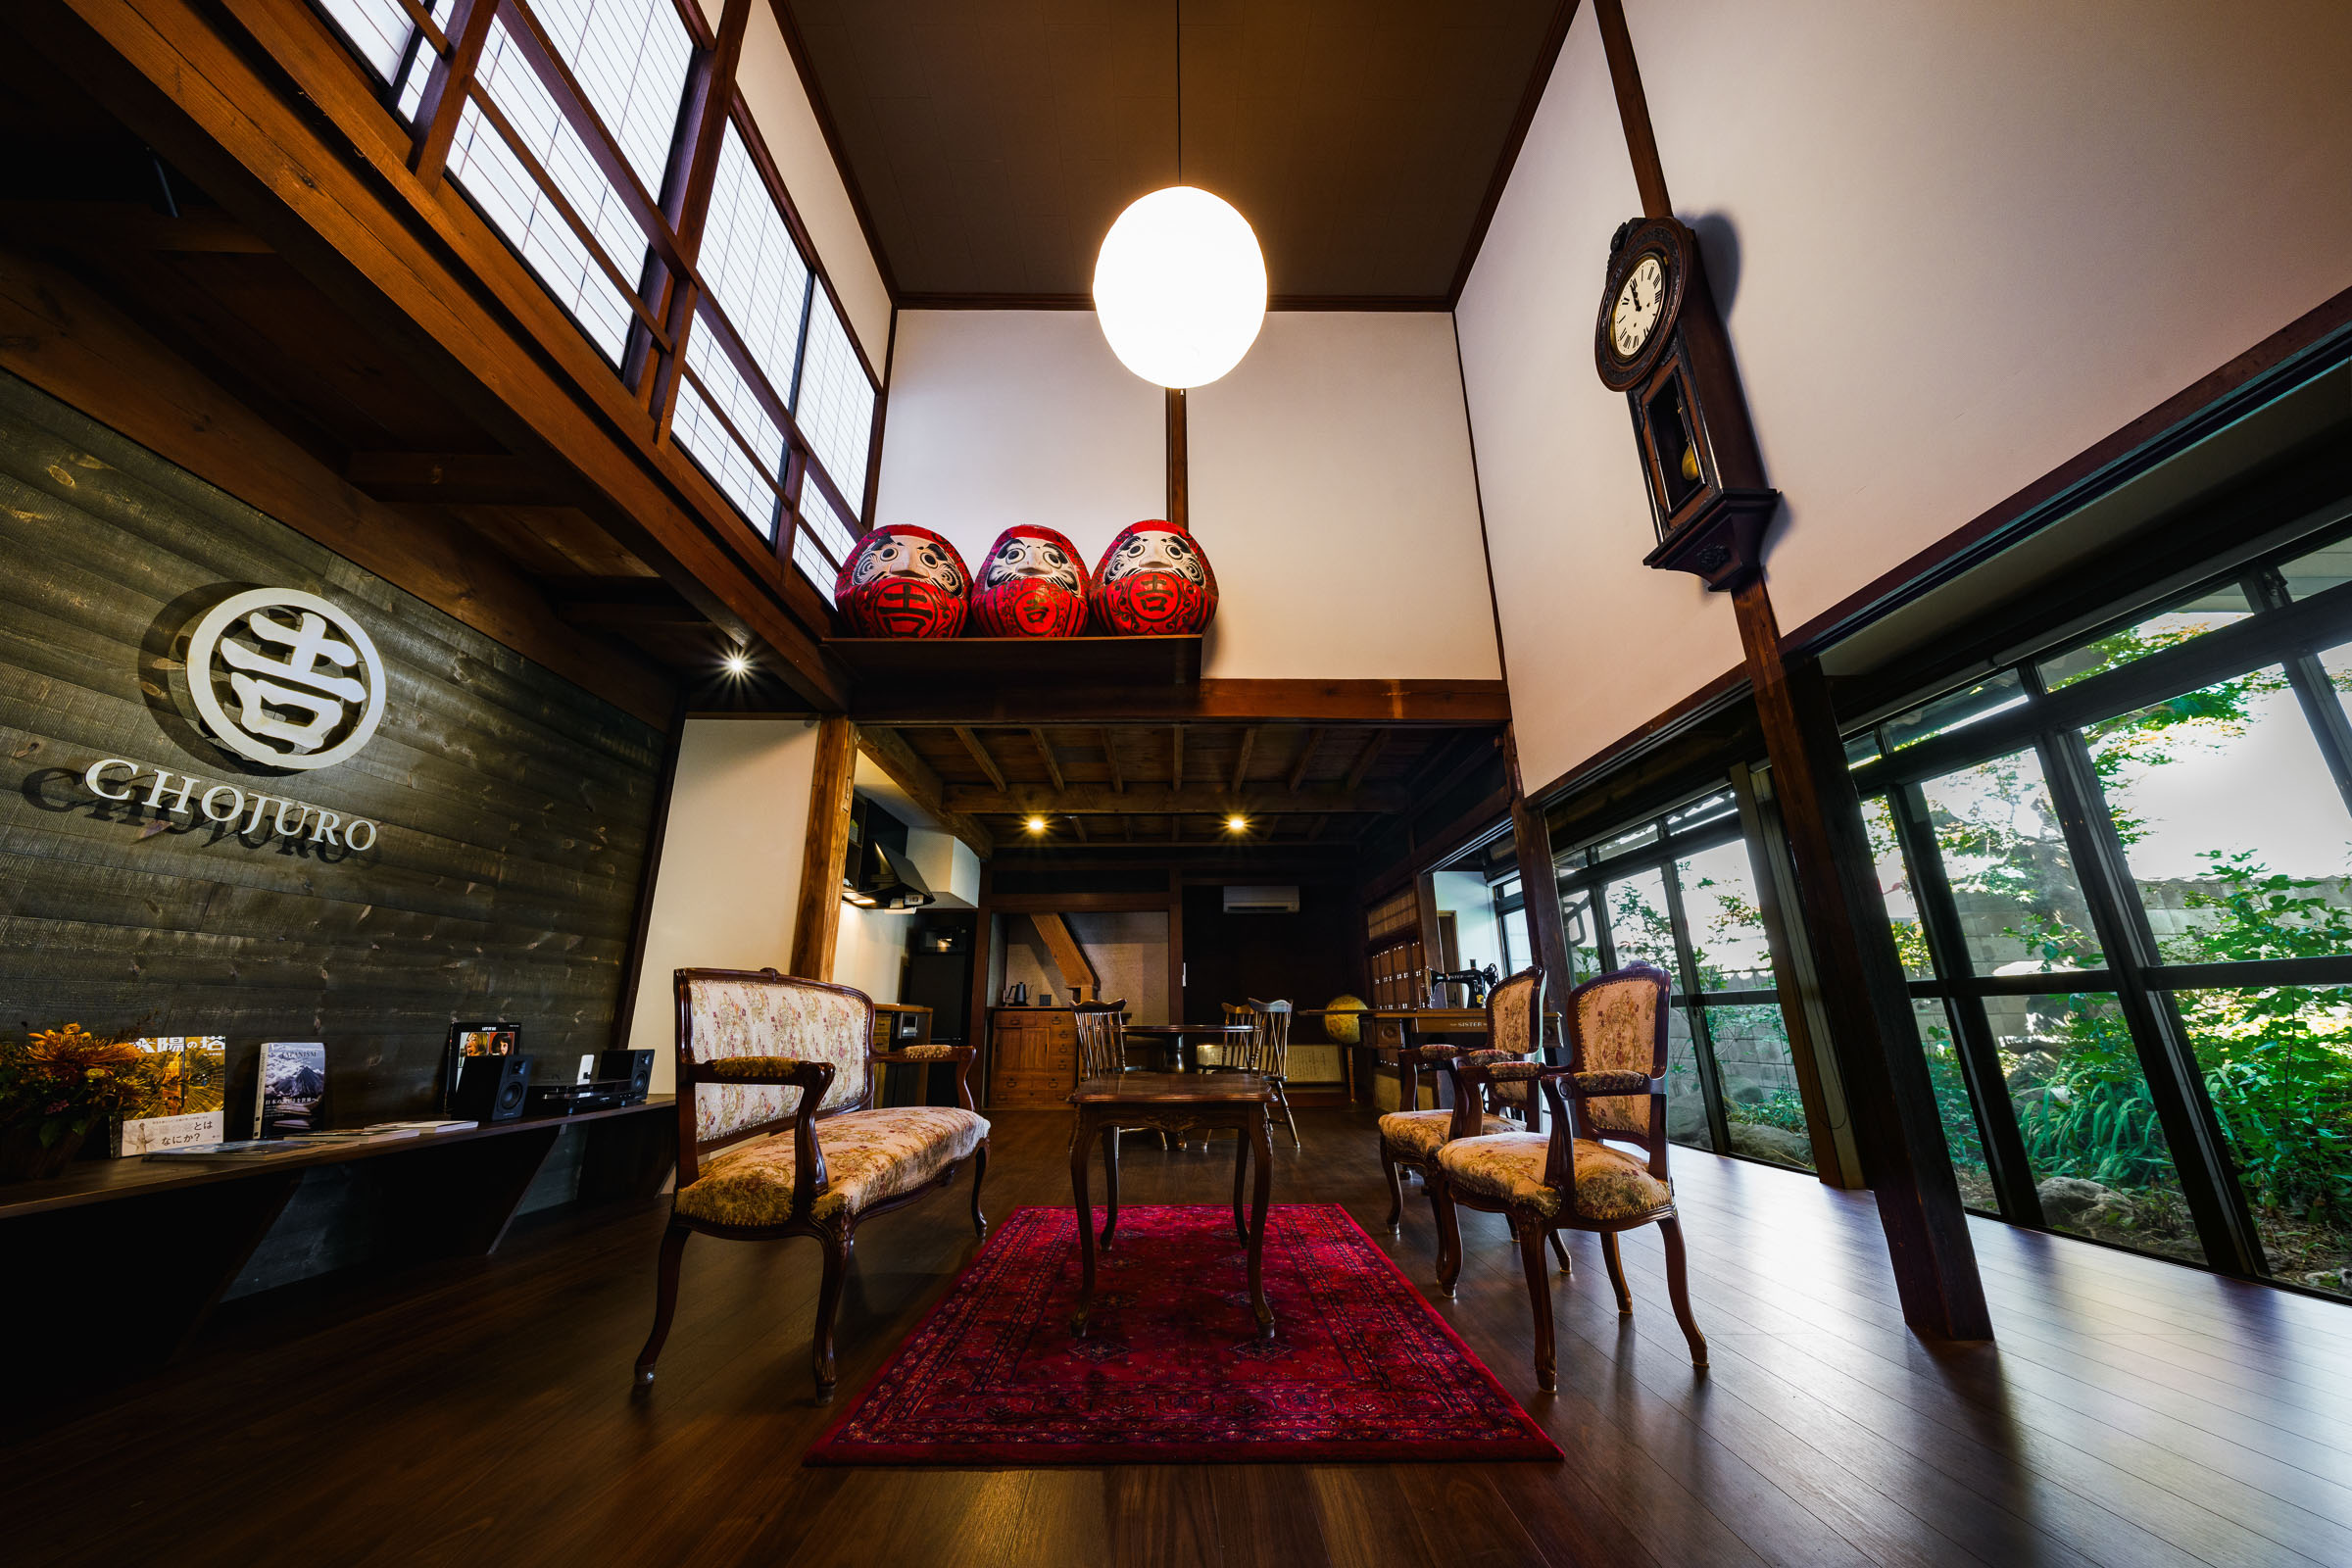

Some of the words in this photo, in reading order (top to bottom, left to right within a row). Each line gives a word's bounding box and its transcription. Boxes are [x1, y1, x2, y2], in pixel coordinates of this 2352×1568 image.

[877, 584, 934, 638] 吉
[1023, 594, 1050, 624] 吉
[1135, 574, 1174, 612] 吉
[84, 758, 378, 853] CHOJURO
[193, 1120, 214, 1131] とは
